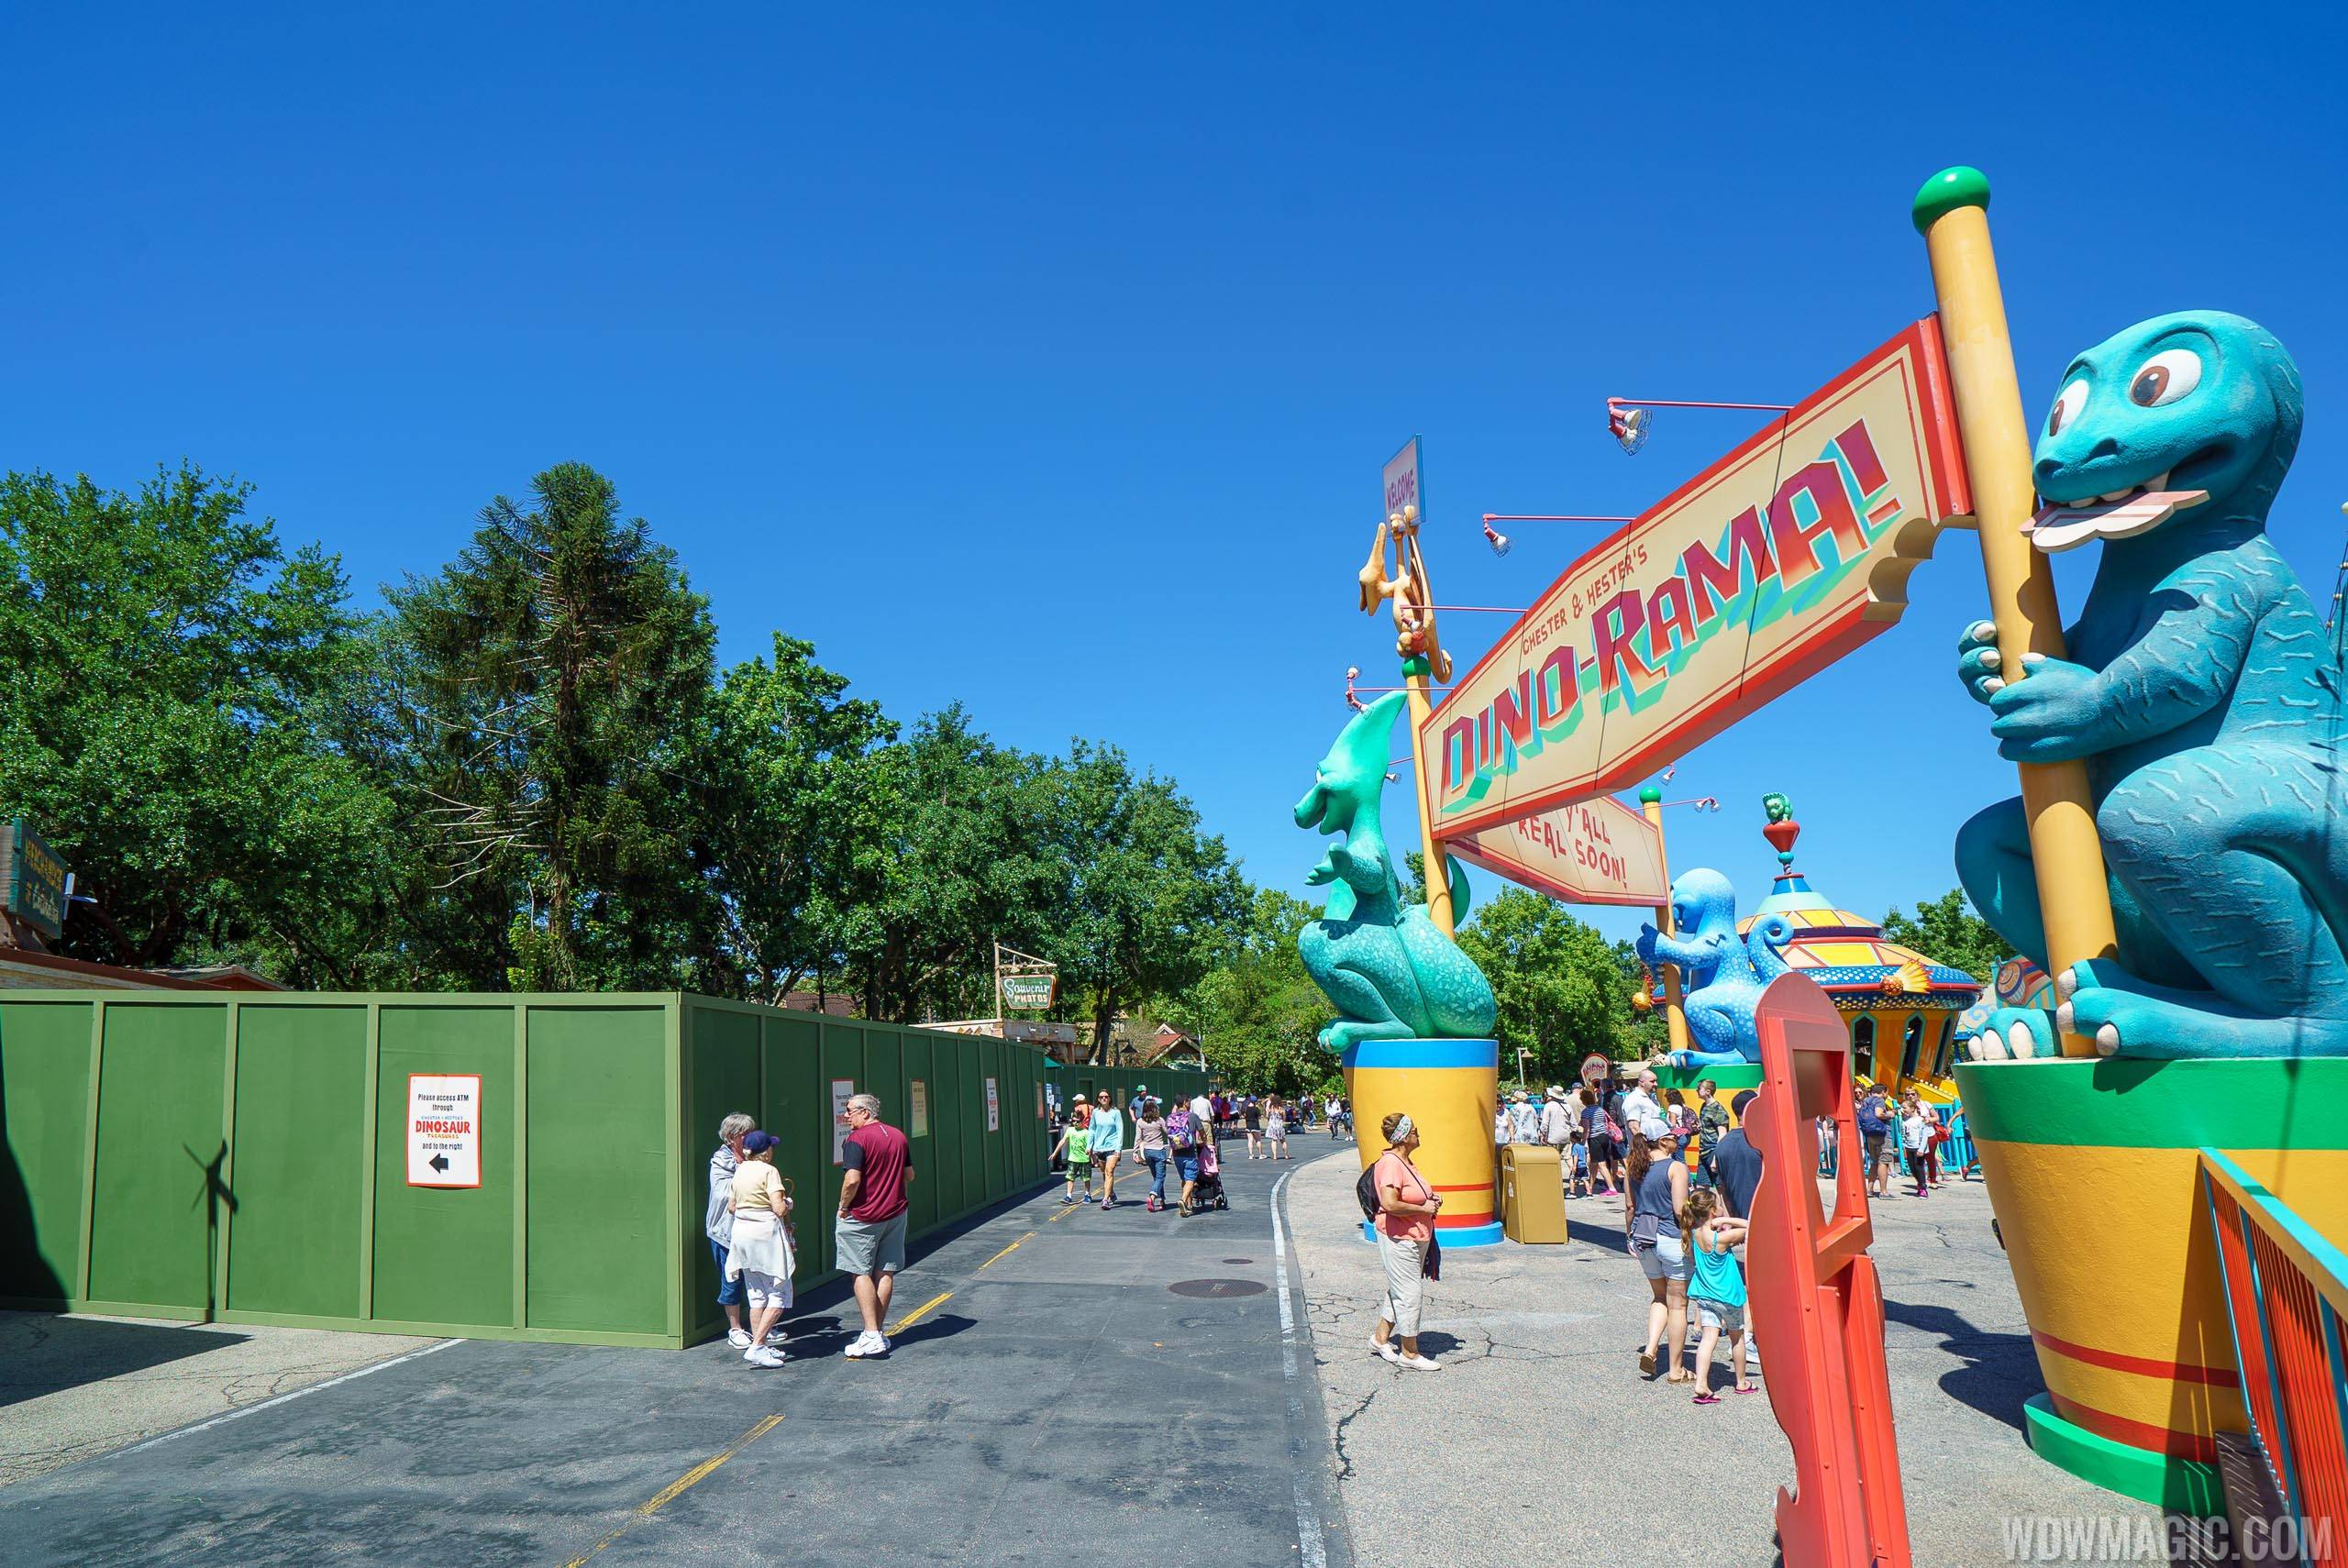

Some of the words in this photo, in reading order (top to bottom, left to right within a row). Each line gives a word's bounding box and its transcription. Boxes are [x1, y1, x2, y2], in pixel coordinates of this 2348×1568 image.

[1387, 469, 1414, 511] WELCOME
[1440, 418, 1904, 812] DINO-RAMA!
[1523, 608, 1567, 656] CHESTER
[1572, 594, 1583, 619] &
[1587, 544, 1647, 606] HESTER'S
[1565, 803, 1611, 845] Y'ALL
[1519, 816, 1567, 858] REAL
[1576, 838, 1628, 889] SOON!
[1003, 978, 1050, 998] Souvenir
[1013, 994, 1047, 1002] PHOTOS
[415, 1121, 471, 1134] DINOSAUR
[449, 1143, 463, 1151] right
